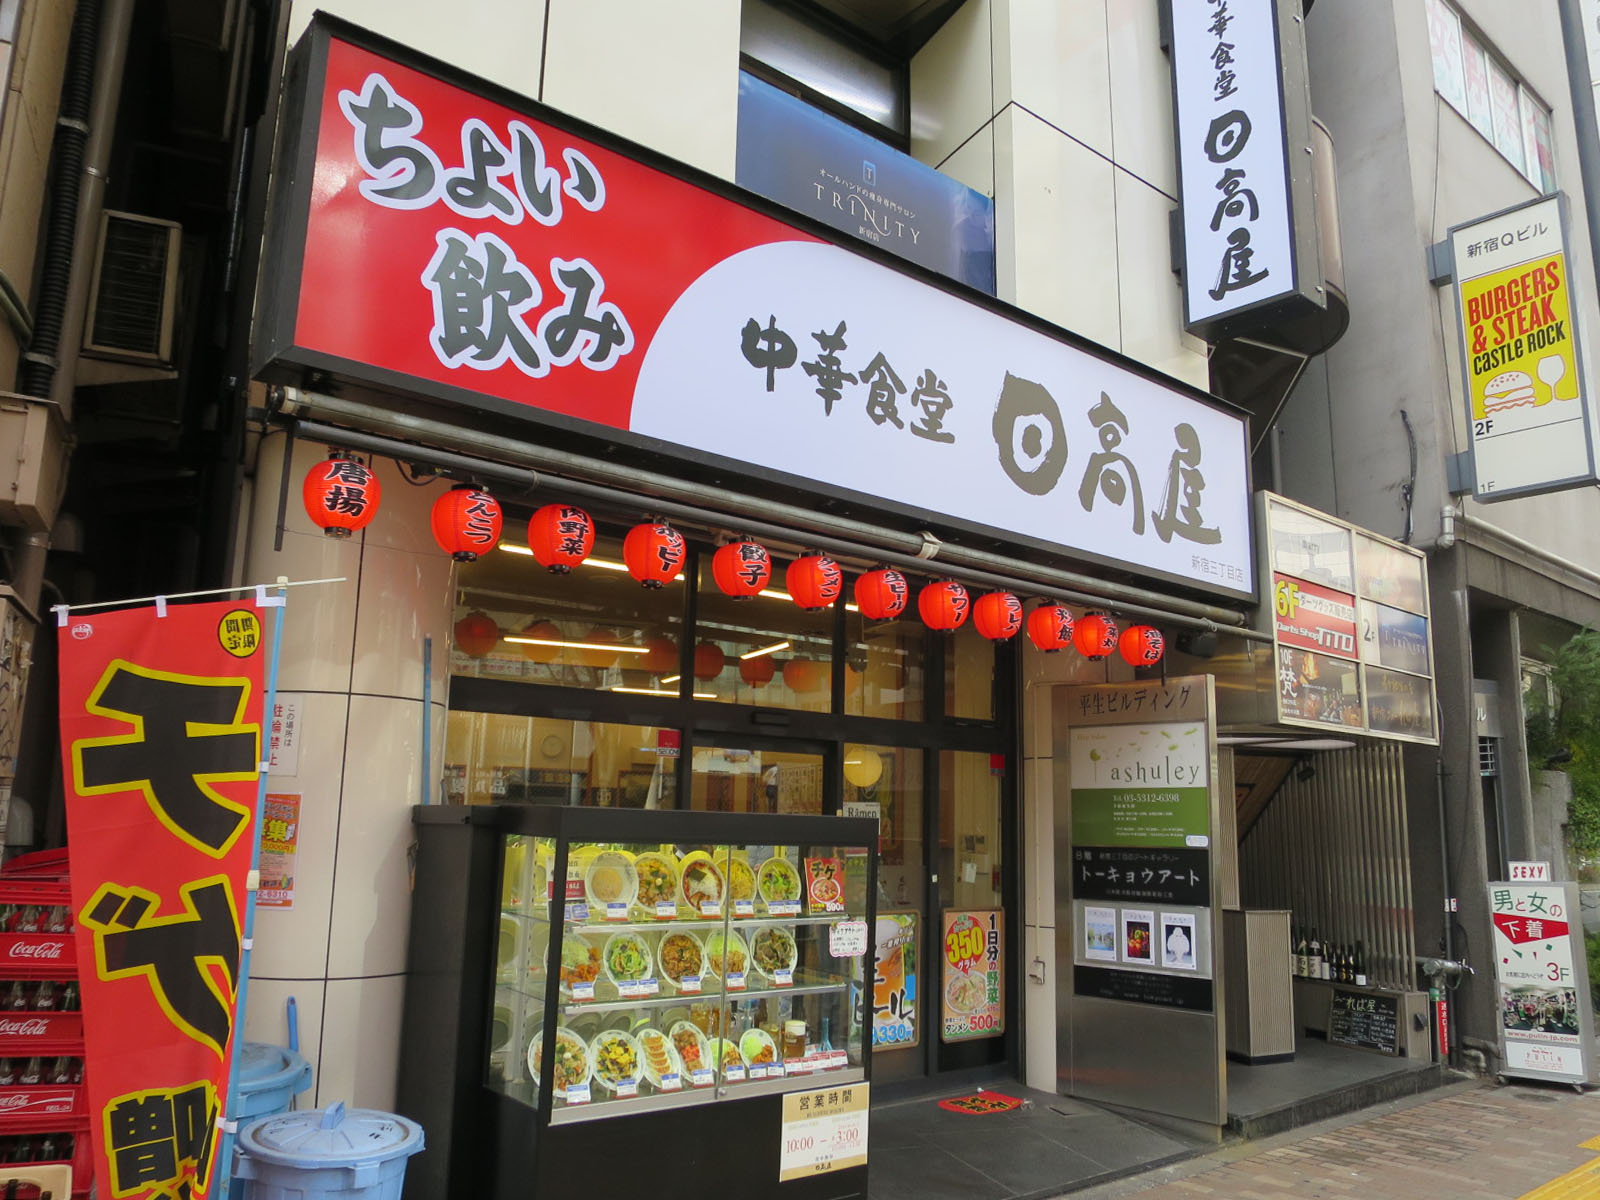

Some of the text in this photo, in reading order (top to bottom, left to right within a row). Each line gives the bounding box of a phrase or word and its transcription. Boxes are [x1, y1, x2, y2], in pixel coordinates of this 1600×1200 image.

[1207, 0, 1238, 101] 華食堂
[337, 72, 605, 226] ちょい
[812, 181, 921, 245] TRINITY
[1204, 110, 1269, 301] 日高屋
[1466, 221, 1549, 258] 新宿Qビル
[421, 227, 634, 378] 飲み
[1467, 259, 1561, 326] BURGERS
[1472, 292, 1558, 355] & STEAK
[1527, 320, 1567, 355] ROCK
[740, 313, 955, 445] 中華食堂
[1475, 420, 1494, 437] 2F
[992, 370, 1222, 544] 日高屋
[323, 460, 373, 518] 唐揚
[738, 543, 768, 587] 餃子
[1275, 578, 1300, 620] 6F
[1110, 755, 1200, 785] ashuley
[1081, 864, 1201, 888] トーキョウアート
[1512, 865, 1544, 879] SEXY
[1493, 889, 1563, 918] 男と女の
[946, 925, 985, 964] 350
[1501, 919, 1544, 939] 下着
[9, 941, 64, 959] Coca-Cola
[1546, 961, 1570, 982] 3F
[799, 1088, 853, 1111] 営業時間
[786, 1135, 815, 1154] 10:00
